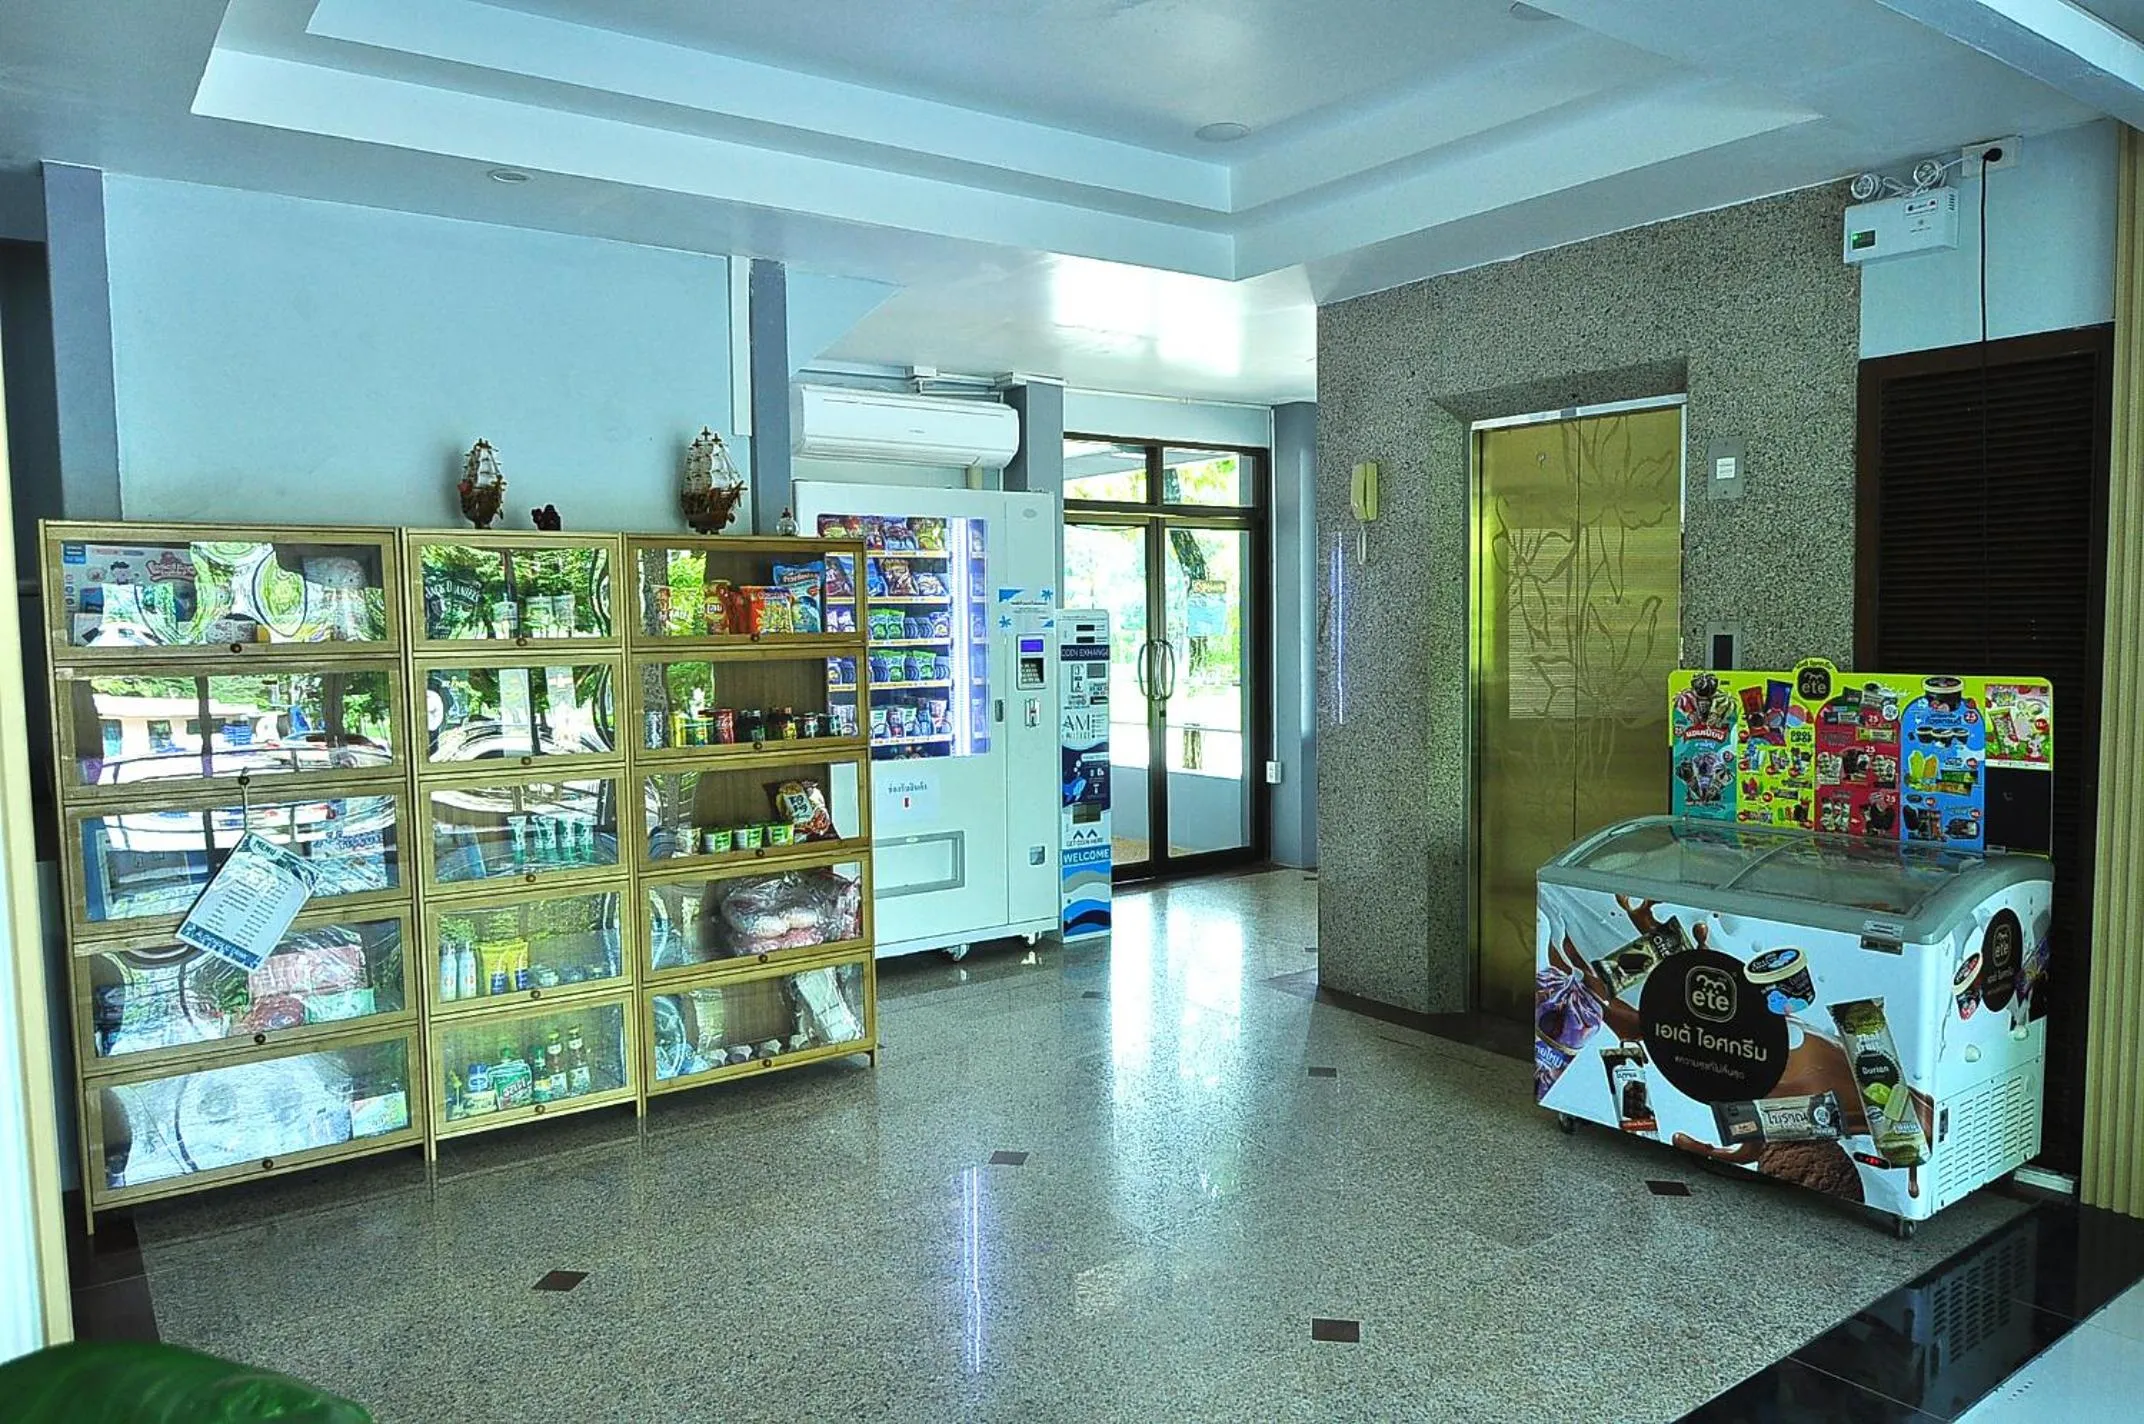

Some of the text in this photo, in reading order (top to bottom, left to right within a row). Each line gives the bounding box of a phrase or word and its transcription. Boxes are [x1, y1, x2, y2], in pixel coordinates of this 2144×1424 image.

[1801, 680, 1827, 694] ete
[254, 840, 277, 856] MENU
[1063, 849, 1109, 863] WELCOME
[1692, 989, 1730, 1012] ete
[1655, 1022, 1768, 1062] เอเต้ ไอศกรีม
[1861, 1065, 1890, 1075] Durian
